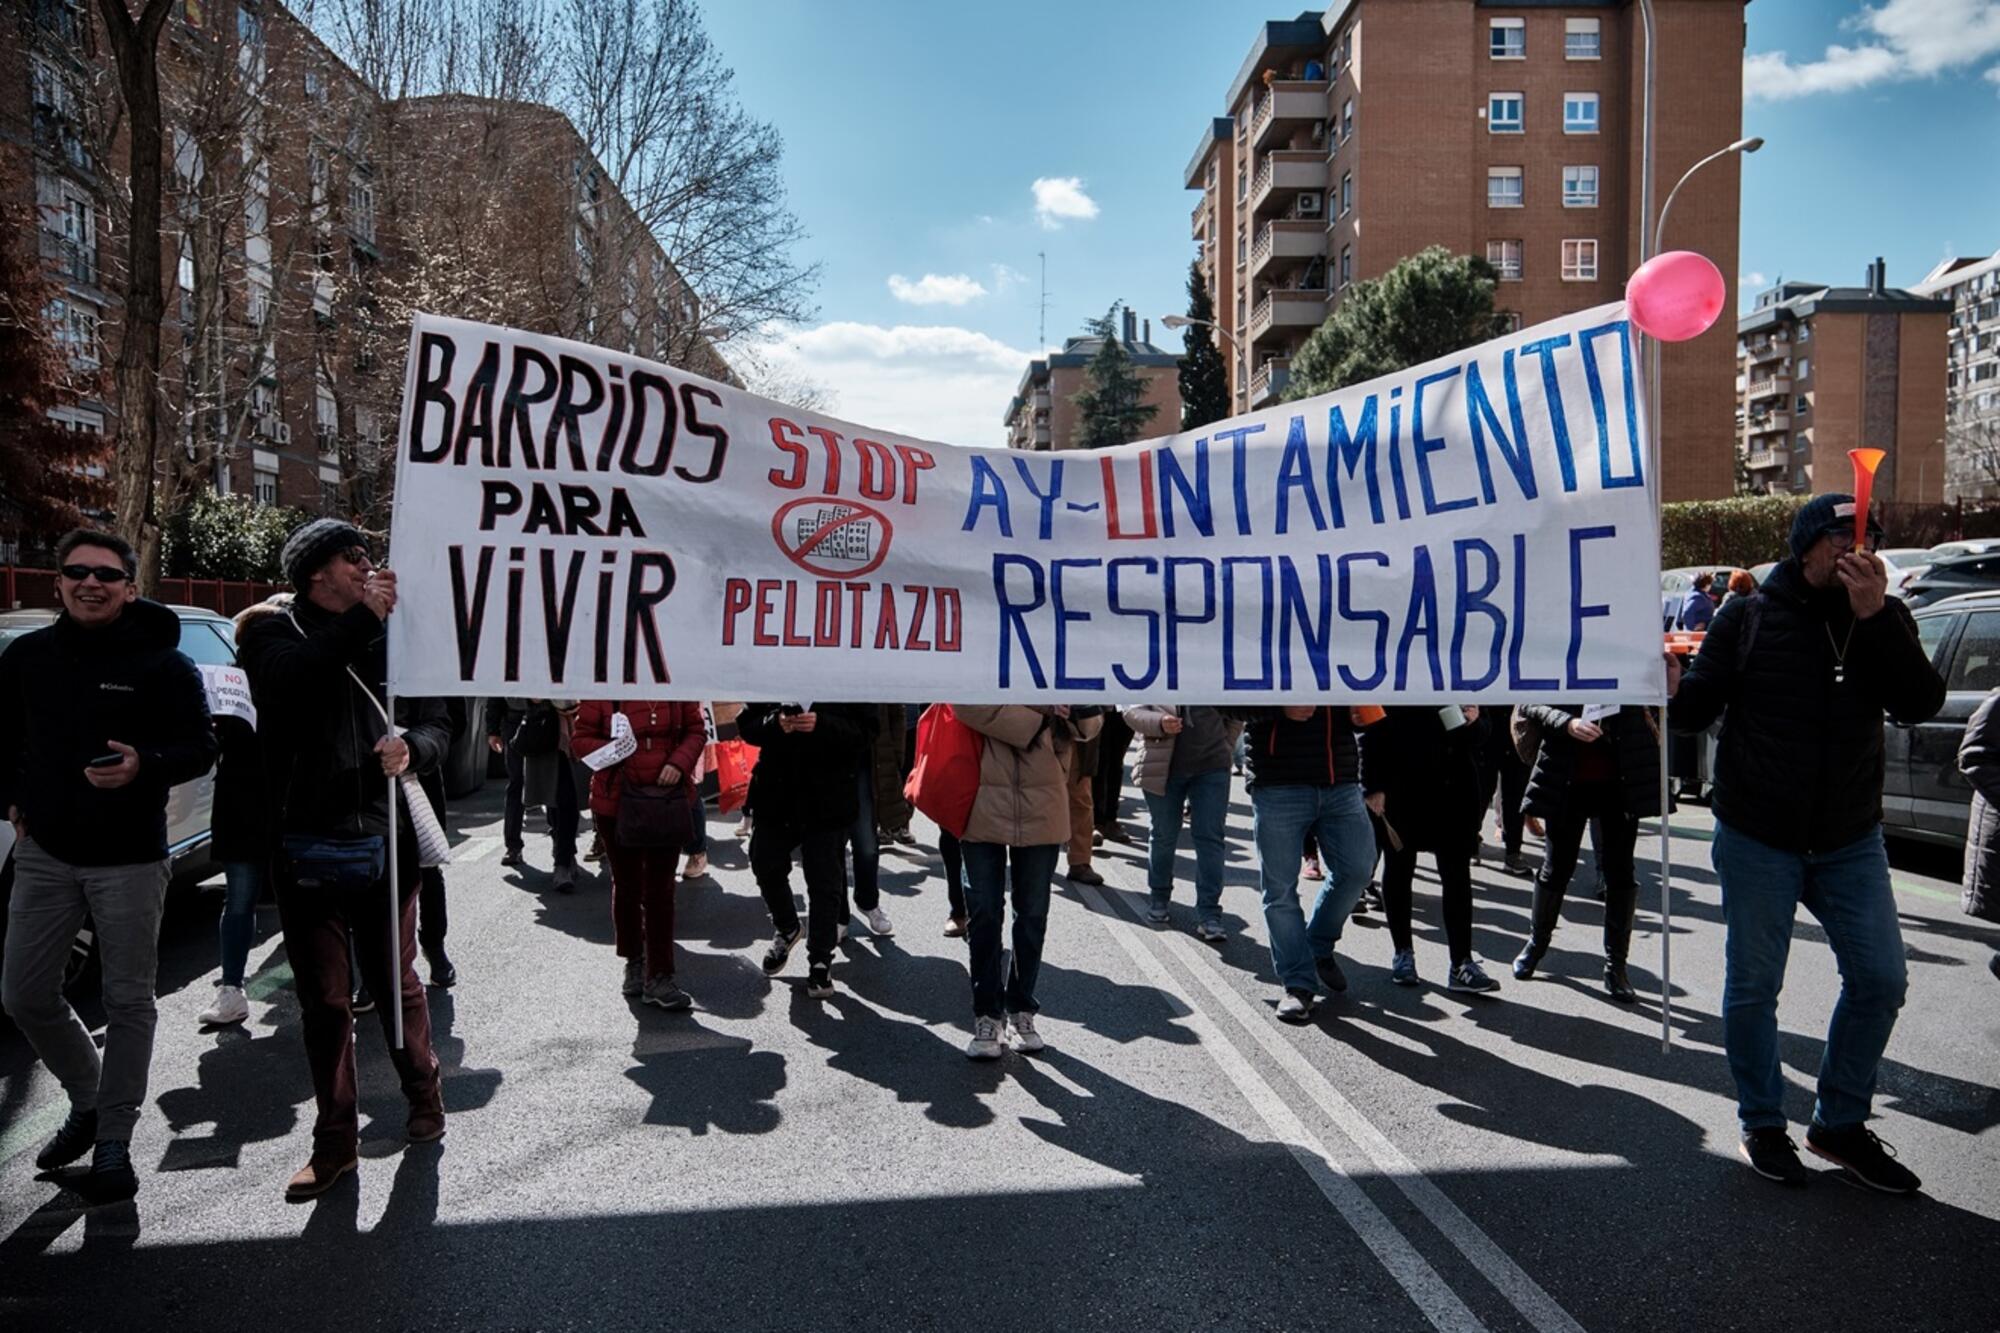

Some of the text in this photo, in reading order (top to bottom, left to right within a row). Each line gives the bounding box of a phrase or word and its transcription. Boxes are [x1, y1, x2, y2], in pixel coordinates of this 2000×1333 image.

[768, 417, 936, 505] STOP
[480, 481, 647, 538] PARA
[722, 578, 962, 652] PELOTAZO
[993, 525, 1618, 691] RESPONSABLE
[224, 674, 243, 685] NO
